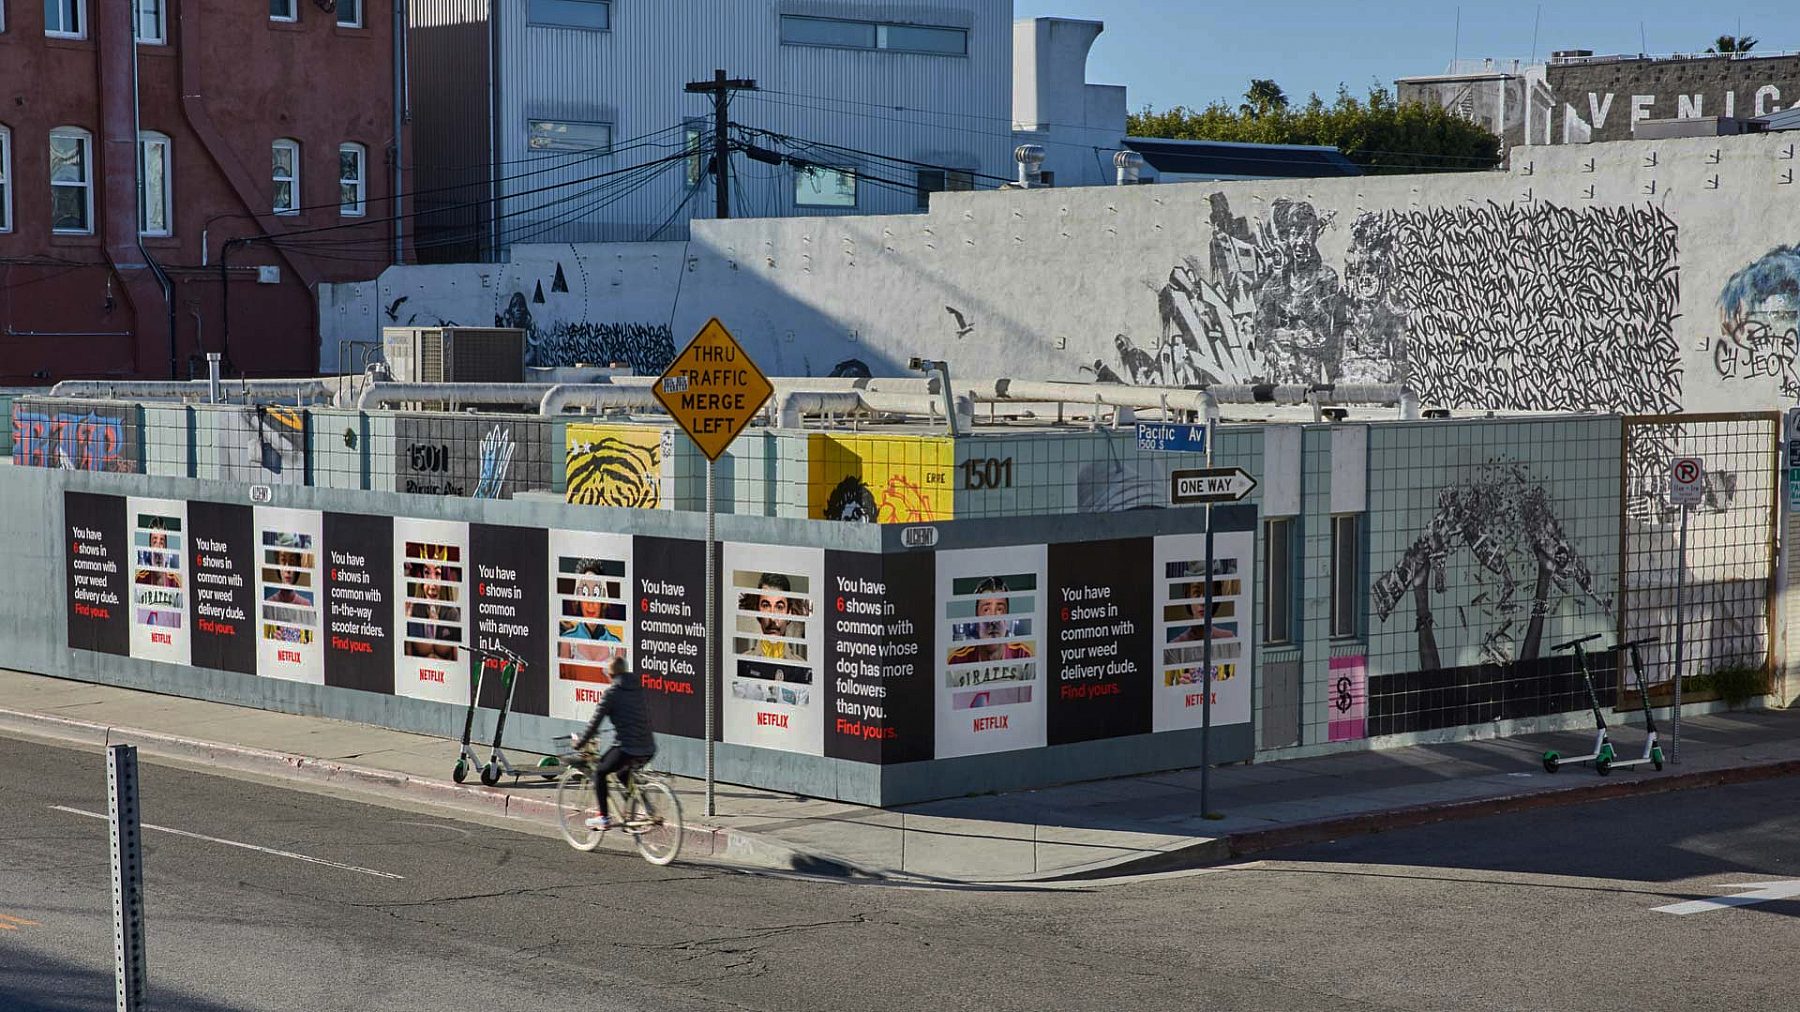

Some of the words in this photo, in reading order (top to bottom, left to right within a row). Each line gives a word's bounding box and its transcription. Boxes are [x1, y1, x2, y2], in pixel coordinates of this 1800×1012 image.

[693, 346, 735, 362] THRU
[680, 370, 748, 386] TRAFFIC
[682, 394, 744, 410] MERGE
[693, 418, 735, 433] LEFT
[1139, 425, 1175, 440] Pacific
[1189, 429, 1202, 442] Av
[1139, 439, 1155, 449] 1500
[960, 457, 1012, 490] 1501
[1181, 480, 1204, 494] ONE
[1207, 478, 1232, 492] WAY
[73, 527, 85, 539] You
[86, 528, 102, 540] have
[73, 543, 79, 553] 6
[79, 543, 99, 555] shows
[100, 545, 106, 556] in
[196, 538, 209, 550] You
[211, 539, 227, 552] have
[74, 560, 101, 571] common
[102, 562, 116, 572] with
[197, 555, 202, 566] 6
[203, 556, 224, 569] shows
[225, 557, 232, 569] in
[331, 551, 345, 564] You
[347, 552, 365, 566] have
[198, 573, 226, 584] common
[228, 574, 242, 587] with
[331, 568, 337, 580] 6
[338, 569, 361, 583] shows
[362, 571, 369, 583] in
[479, 564, 494, 578] You
[496, 567, 516, 580] have
[74, 574, 88, 586] your
[89, 576, 107, 587] weed
[642, 579, 659, 594] You
[662, 580, 685, 596] have
[837, 576, 857, 592] You
[860, 579, 886, 595] have
[75, 588, 100, 604] delivery
[101, 591, 119, 604] dude.
[198, 589, 213, 601] your
[215, 590, 232, 601] weed
[332, 588, 364, 600] common
[365, 589, 381, 602] with
[479, 583, 485, 594] 6
[486, 584, 513, 598] shows
[514, 585, 521, 599] in
[1061, 588, 1082, 601] You
[1085, 585, 1111, 599] have
[75, 603, 89, 615] Find
[90, 607, 110, 619] yours.
[198, 603, 225, 620] delivery
[226, 606, 245, 620] dude.
[332, 602, 372, 620] in-the-way
[479, 603, 515, 617] common
[641, 598, 648, 612] 6
[650, 600, 680, 616] shows
[682, 602, 691, 616] in
[836, 597, 845, 611] 6
[846, 601, 882, 615] shows
[884, 601, 894, 615] in
[1061, 607, 1069, 622] 6
[1071, 606, 1105, 621] shows
[1108, 603, 1118, 617] in
[199, 619, 213, 631] Find
[215, 623, 235, 635] yours.
[332, 621, 360, 634] scooter
[361, 623, 384, 637] riders.
[479, 619, 496, 632] with
[498, 624, 529, 638] anyone
[641, 620, 683, 635] common
[685, 622, 706, 638] with
[836, 620, 885, 636] common
[888, 620, 914, 635] with
[1061, 625, 1109, 640] common
[1111, 621, 1134, 636] with
[151, 632, 171, 644] NETFLIX
[332, 636, 348, 649] Find
[350, 640, 372, 653] yours.
[479, 636, 487, 650] in
[641, 638, 676, 655] anyone
[678, 642, 698, 656] else
[836, 641, 877, 657] anyone
[879, 641, 918, 656] whose
[1061, 648, 1086, 664] your
[1088, 641, 1117, 657] weed
[278, 650, 300, 663] NETFLIX
[641, 656, 668, 675] doing
[670, 659, 695, 675] Keto.
[836, 658, 858, 678] dog
[860, 662, 880, 676] has
[882, 663, 914, 677] more
[1061, 663, 1105, 680] delivery
[1107, 659, 1137, 675] dude.
[420, 668, 444, 683] NETFLIX
[642, 675, 662, 689] Find
[665, 678, 693, 695] yours.
[836, 679, 886, 699] followers
[1061, 683, 1086, 698] Find
[576, 688, 602, 702] NETFLI
[1185, 692, 1216, 708] NETFX
[836, 698, 860, 716] than
[863, 703, 887, 720] you.
[757, 712, 789, 728] NETFLIX
[973, 715, 1009, 733] NETFLIX
[836, 719, 860, 736] Find
[863, 724, 897, 740] yours.
